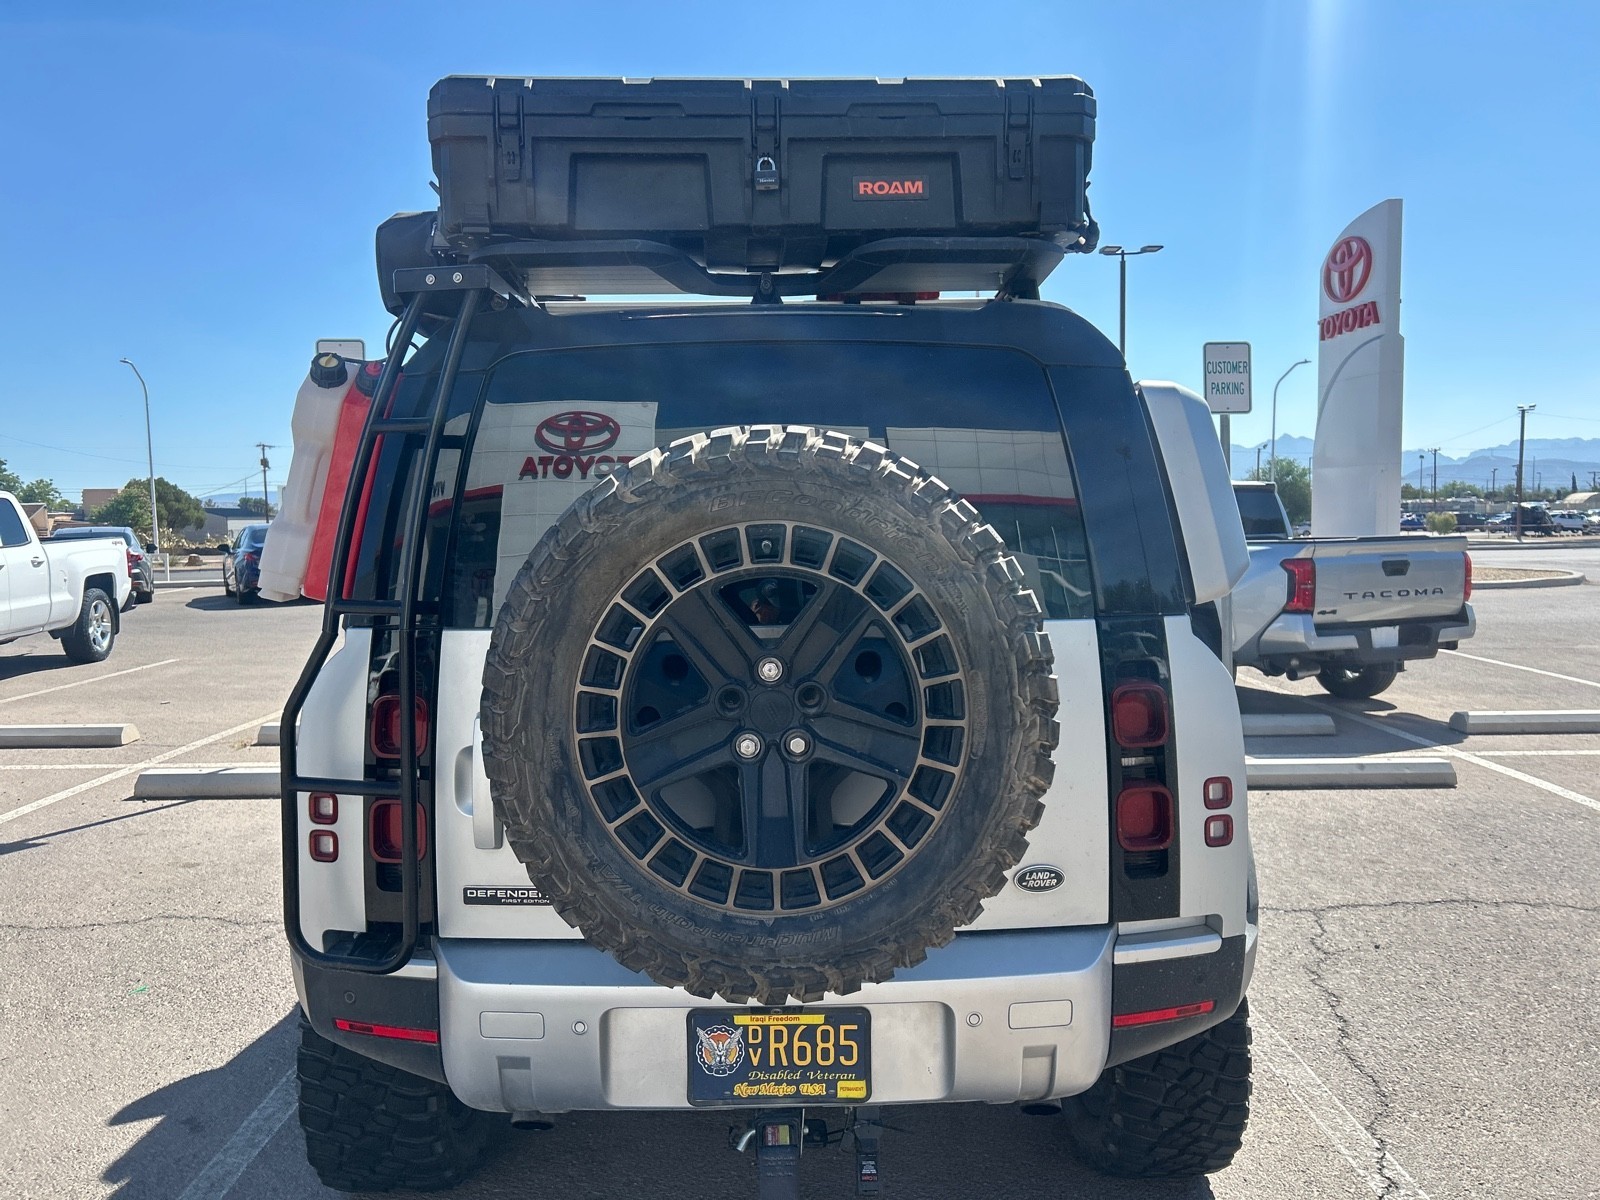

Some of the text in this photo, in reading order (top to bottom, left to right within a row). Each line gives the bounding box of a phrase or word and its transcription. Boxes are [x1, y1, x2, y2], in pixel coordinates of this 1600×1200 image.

[858, 180, 924, 196] ROAM
[1317, 301, 1380, 341] TOYOTA
[1206, 360, 1248, 374] CUSTOMER
[1211, 382, 1245, 395] PARKING
[1343, 587, 1444, 600] TACOMA
[467, 889, 549, 898] DEFENDE
[769, 1025, 858, 1067] R685
[749, 1070, 856, 1081] Disabled Veteran
[733, 1083, 826, 1097] New Mexico USA
